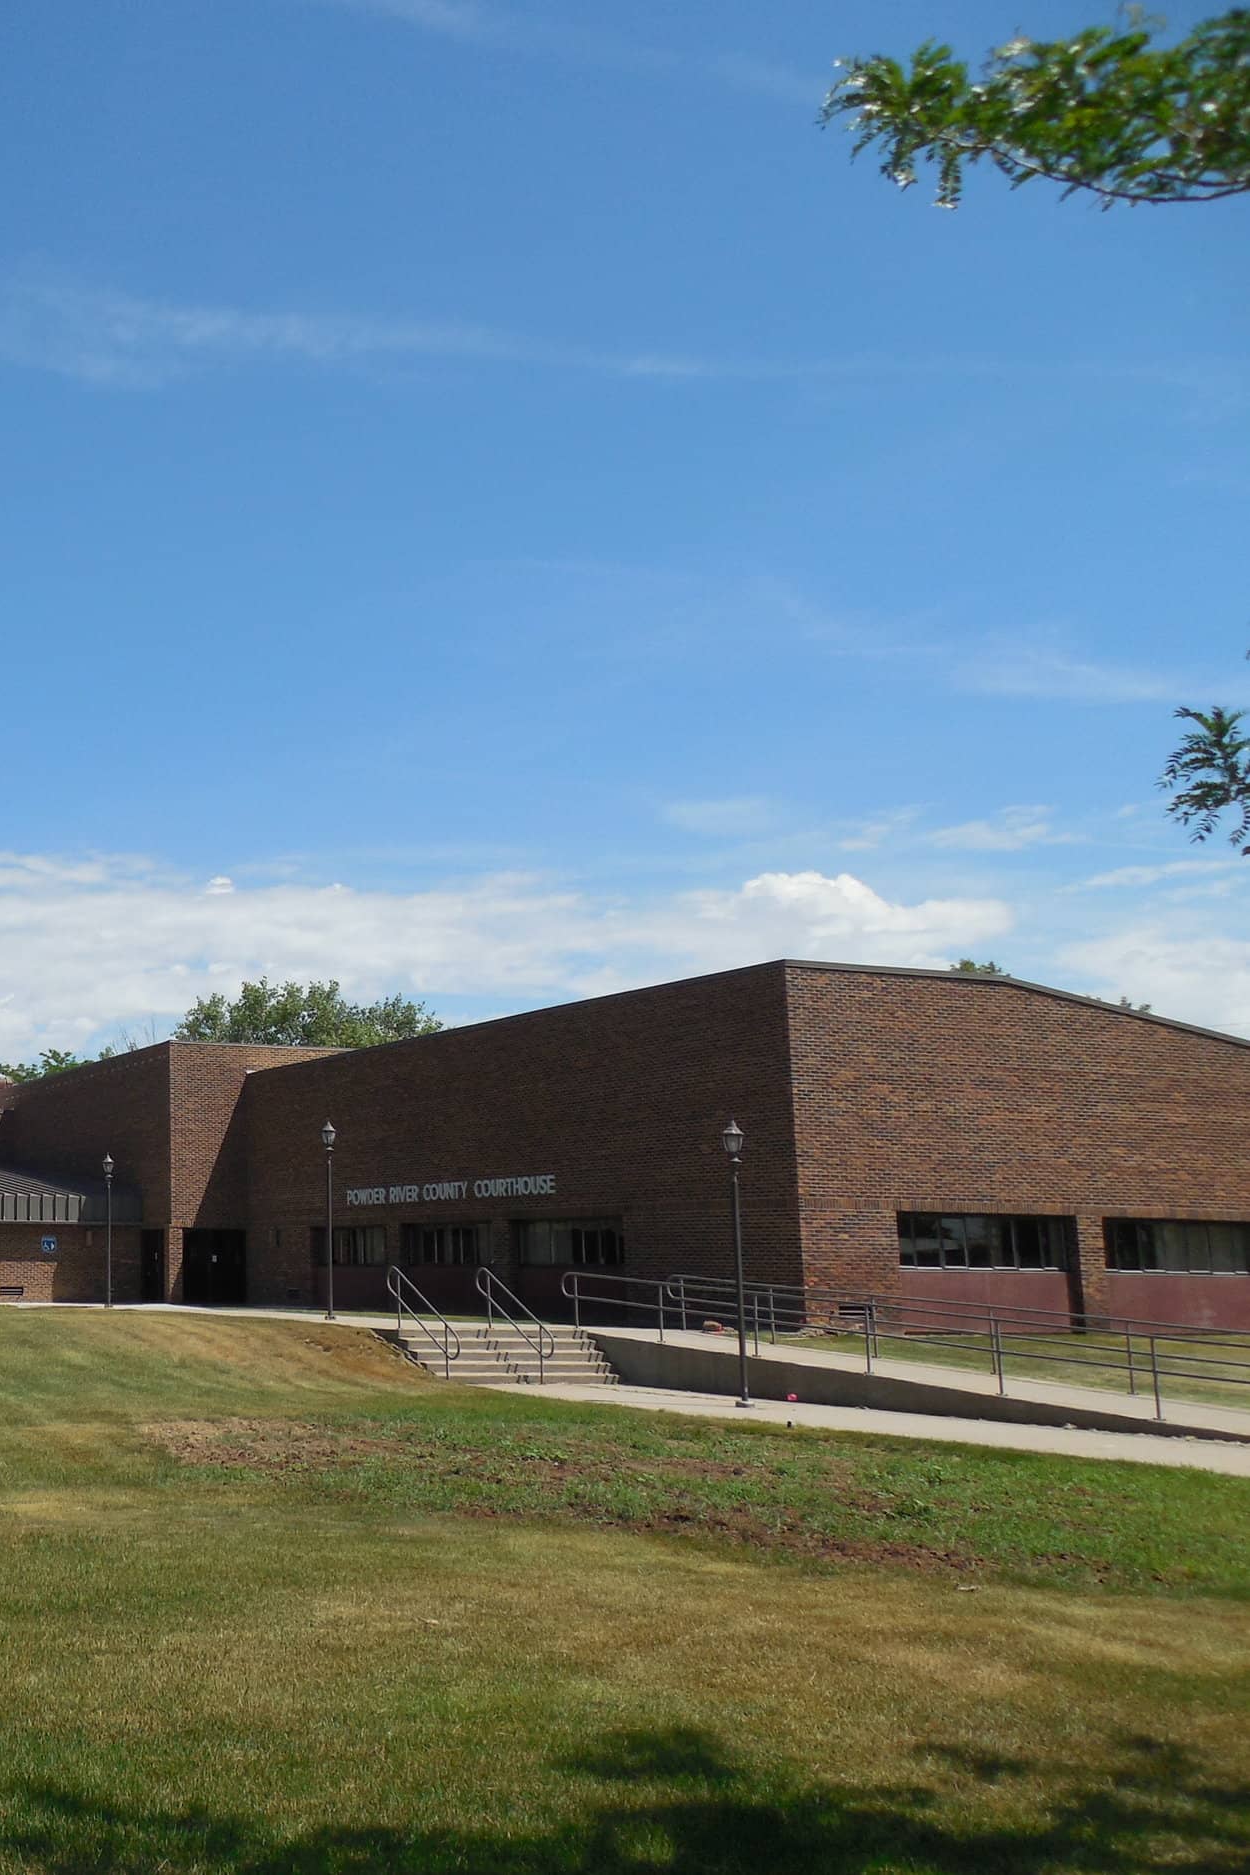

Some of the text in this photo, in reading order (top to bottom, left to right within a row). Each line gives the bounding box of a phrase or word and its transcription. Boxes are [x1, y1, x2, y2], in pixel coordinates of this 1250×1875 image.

[346, 1175, 556, 1205] POWDER RIVER COUNTY COURTHOUSE
